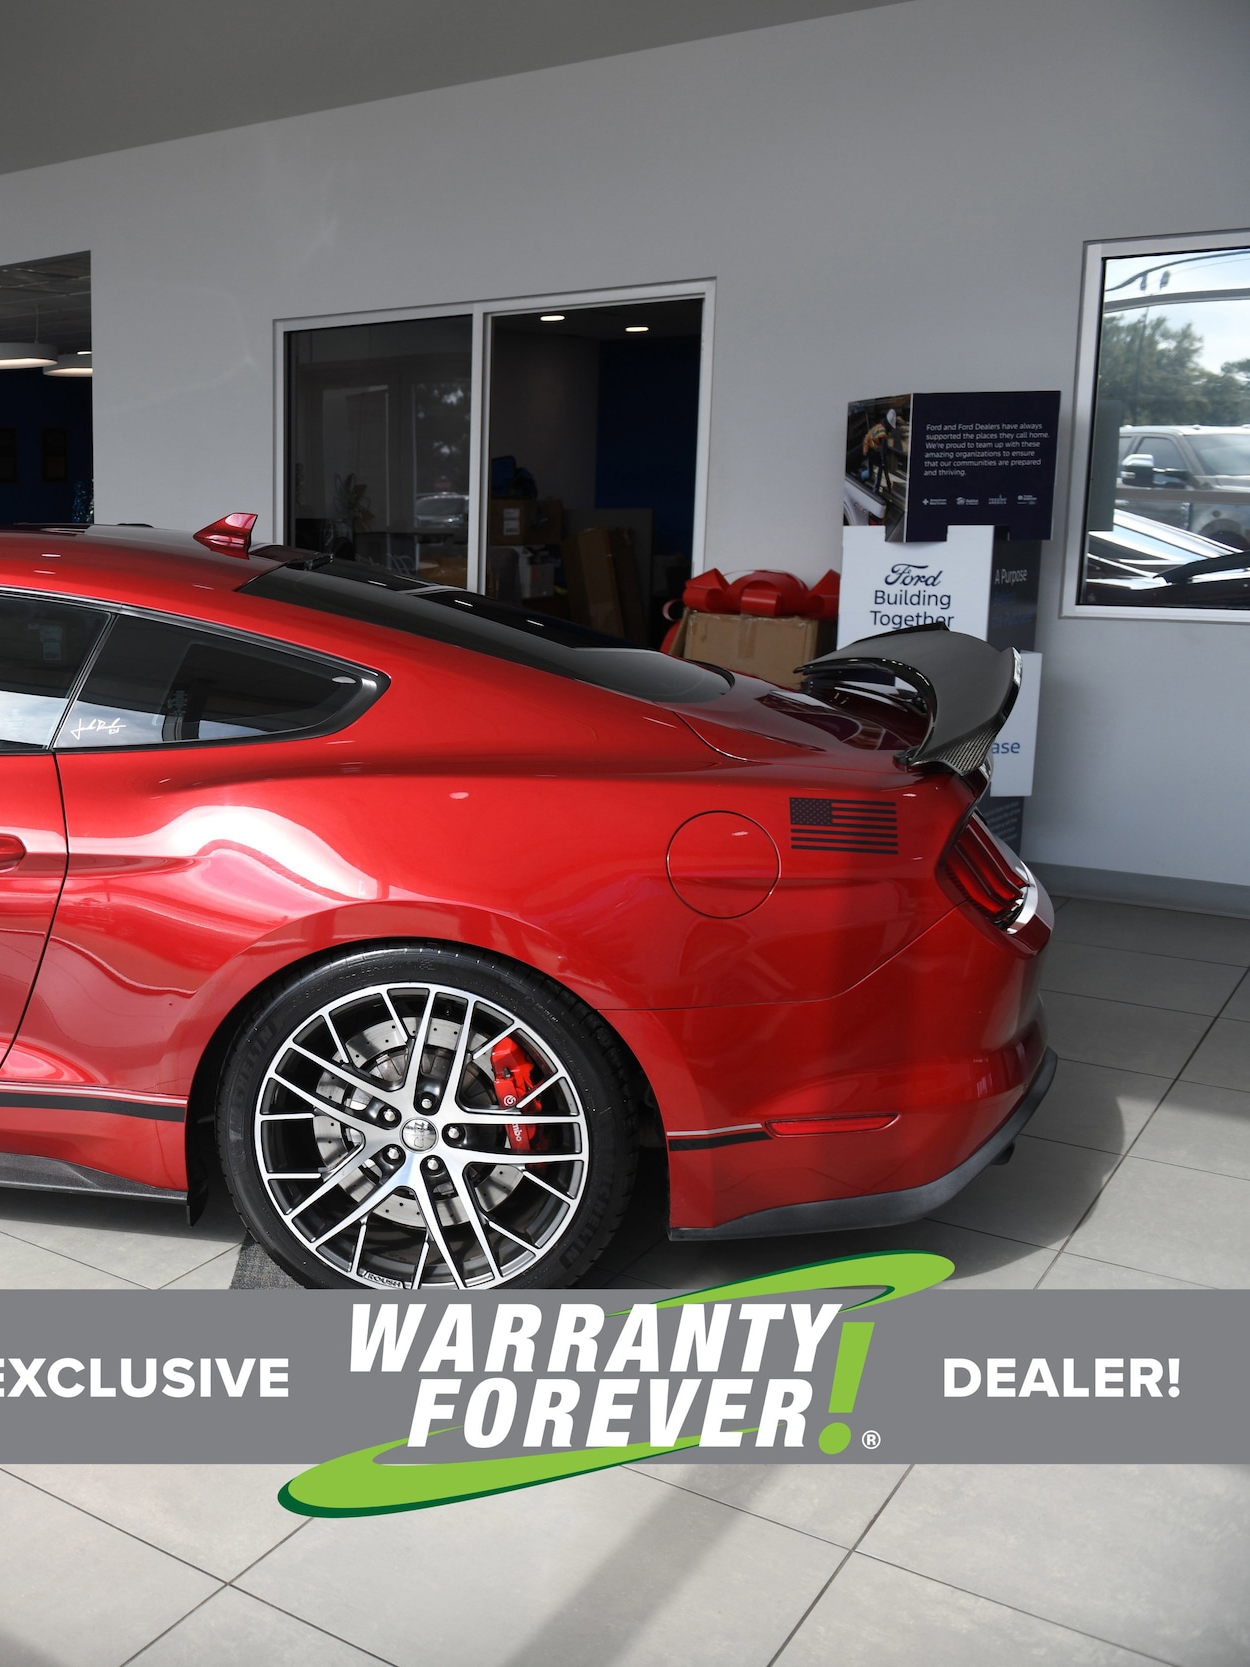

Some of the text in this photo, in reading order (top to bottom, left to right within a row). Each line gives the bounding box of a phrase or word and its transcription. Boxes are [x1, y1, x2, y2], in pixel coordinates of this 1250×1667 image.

[943, 423, 956, 431] and
[976, 432, 997, 440] places
[999, 432, 1014, 440] they
[925, 451, 954, 459] amazing
[955, 451, 1001, 459] organizations
[1011, 458, 1041, 466] prepared
[939, 469, 966, 477] thriving.
[884, 563, 944, 587] Ford
[1001, 568, 1028, 587] Purpose
[874, 589, 951, 610] Building
[870, 610, 954, 629] Together
[991, 742, 1020, 754] ase
